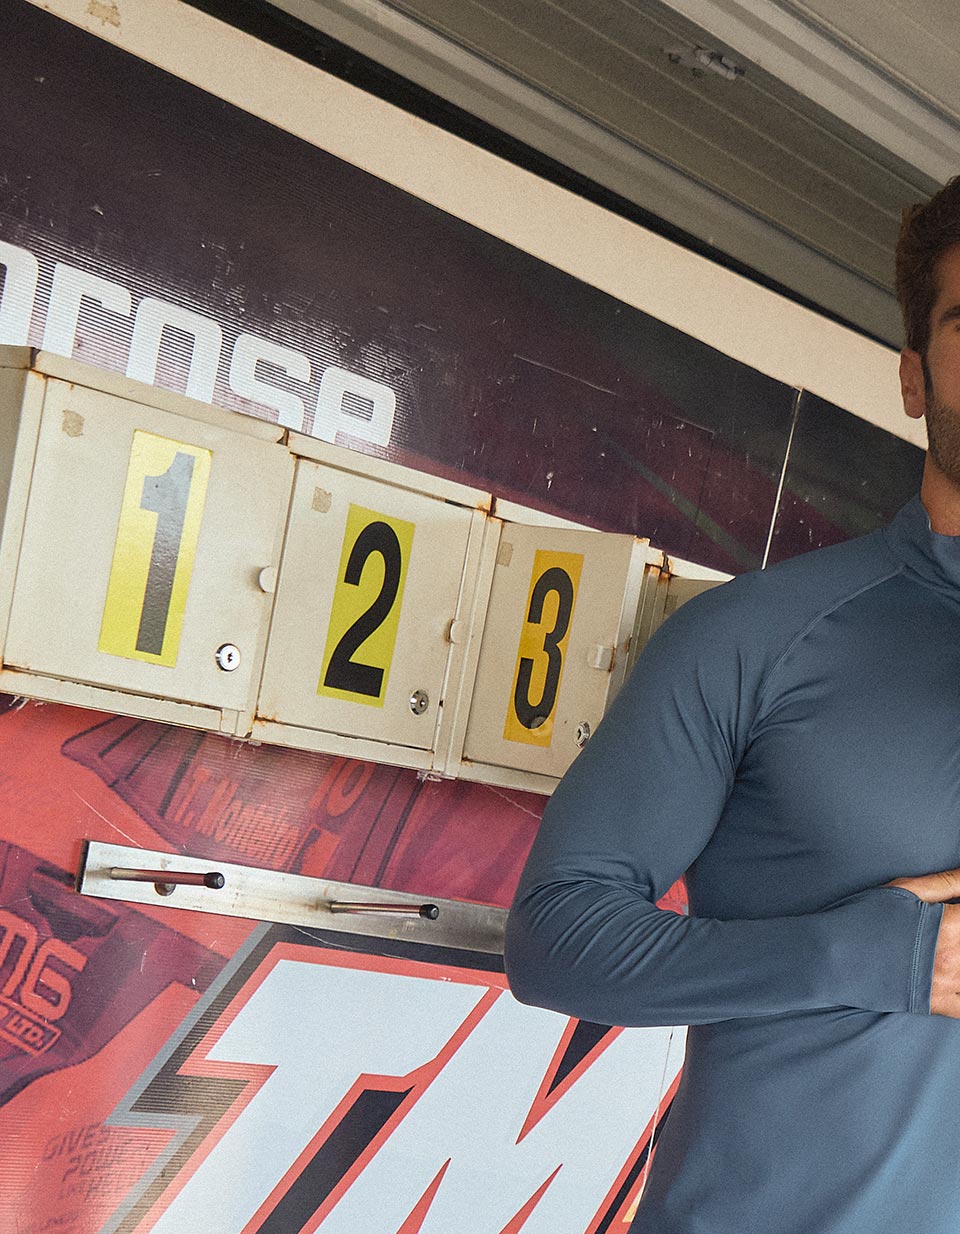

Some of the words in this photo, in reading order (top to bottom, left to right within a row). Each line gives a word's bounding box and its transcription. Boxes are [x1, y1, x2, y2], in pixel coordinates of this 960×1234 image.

[135, 451, 196, 657] 1
[323, 521, 403, 699] 2
[514, 567, 575, 731] 3
